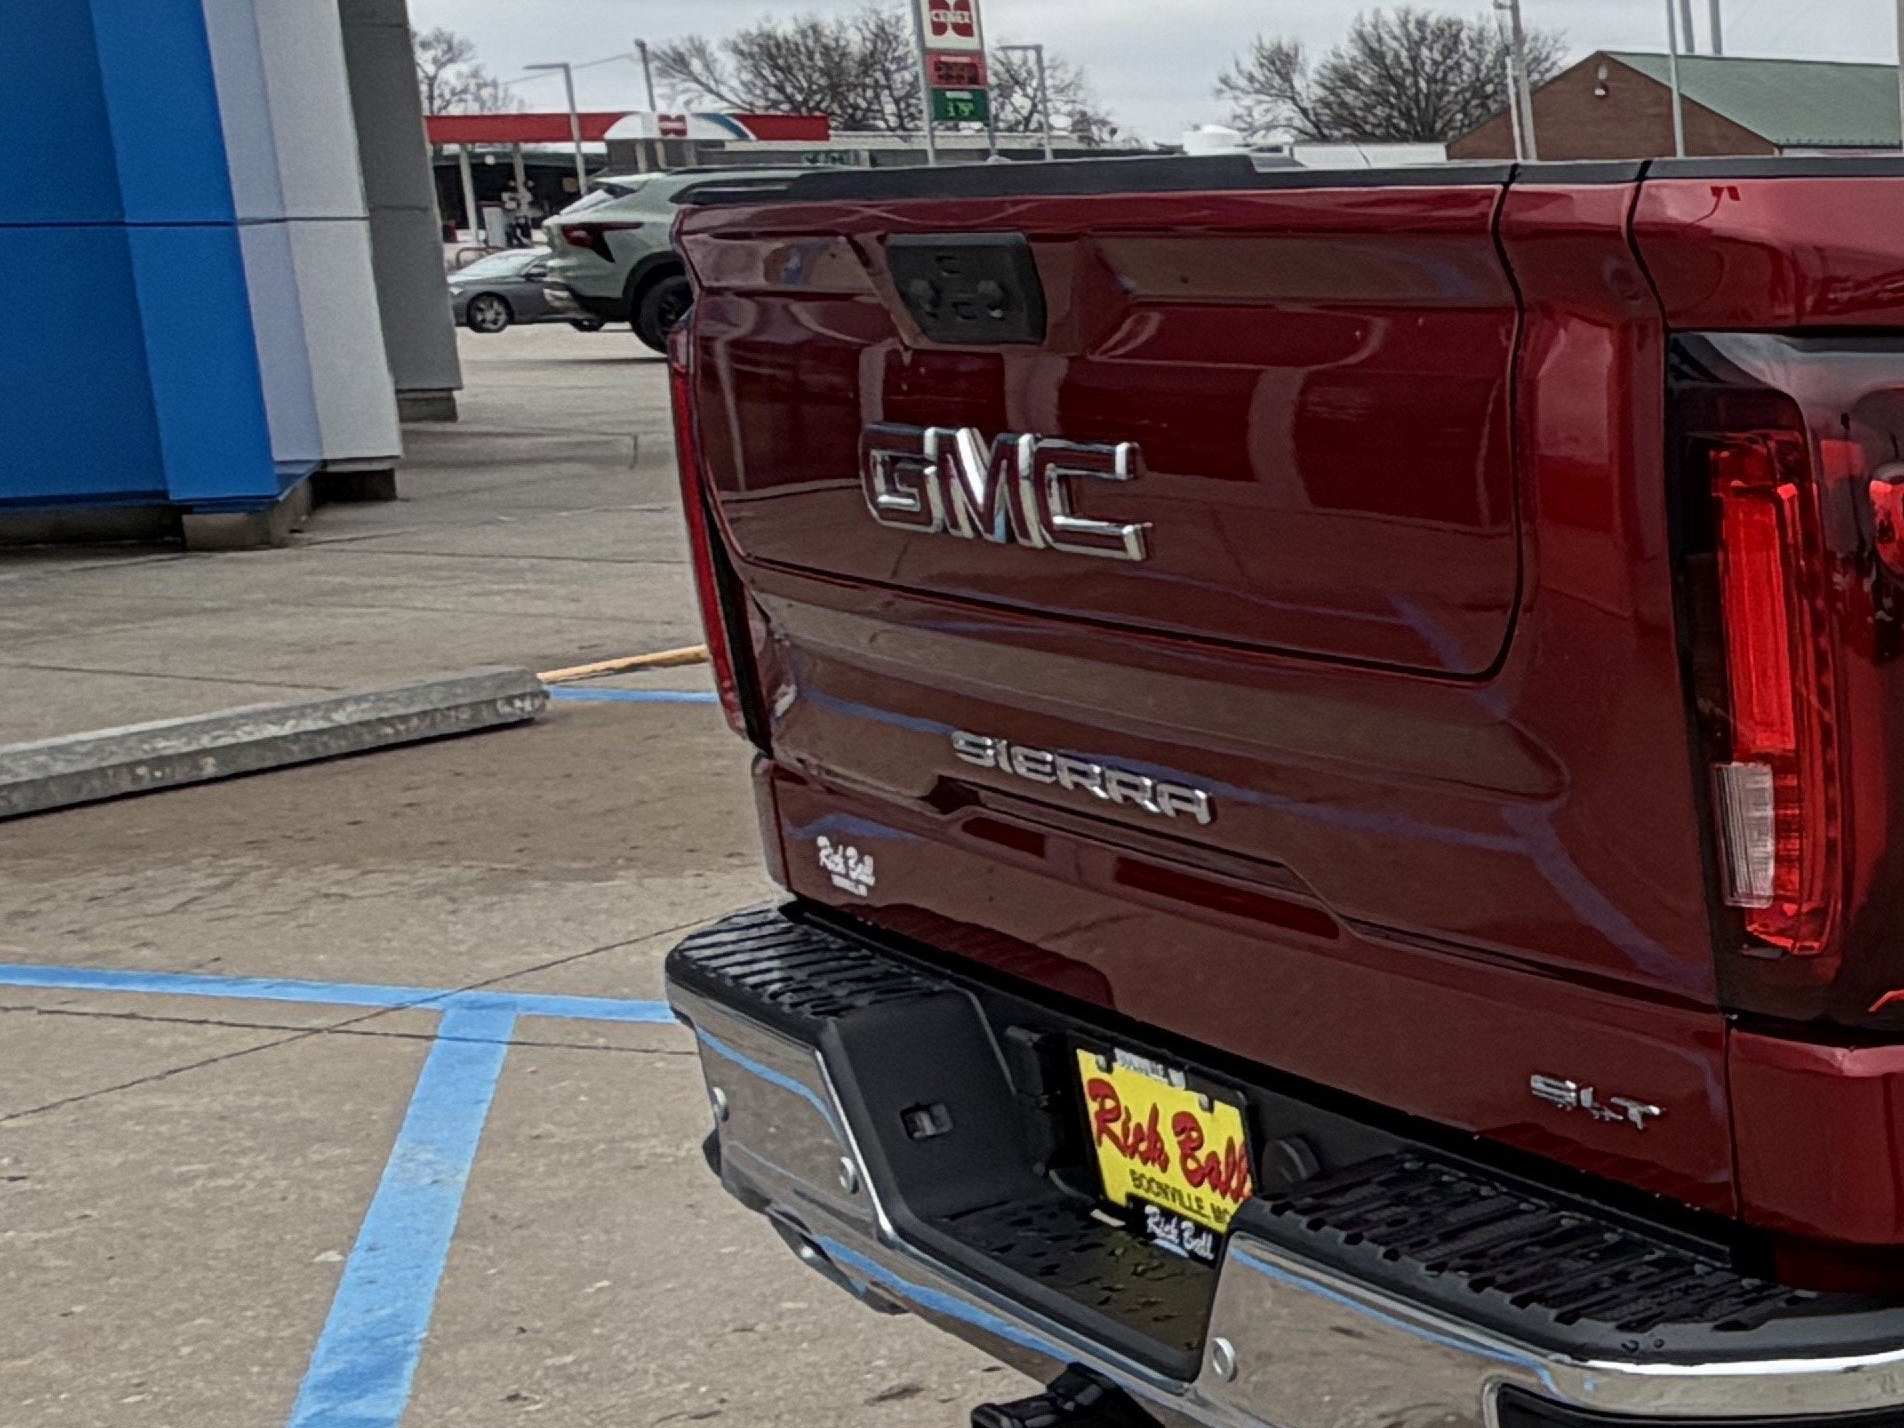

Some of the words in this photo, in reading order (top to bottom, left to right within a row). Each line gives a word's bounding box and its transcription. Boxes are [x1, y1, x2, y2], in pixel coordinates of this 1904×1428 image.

[859, 421, 1152, 562] GMC
[951, 730, 1214, 825] SIERRA
[1087, 1078, 1169, 1173] Rick
[1171, 1110, 1253, 1203] Ball
[1530, 1074, 1665, 1130] SLT
